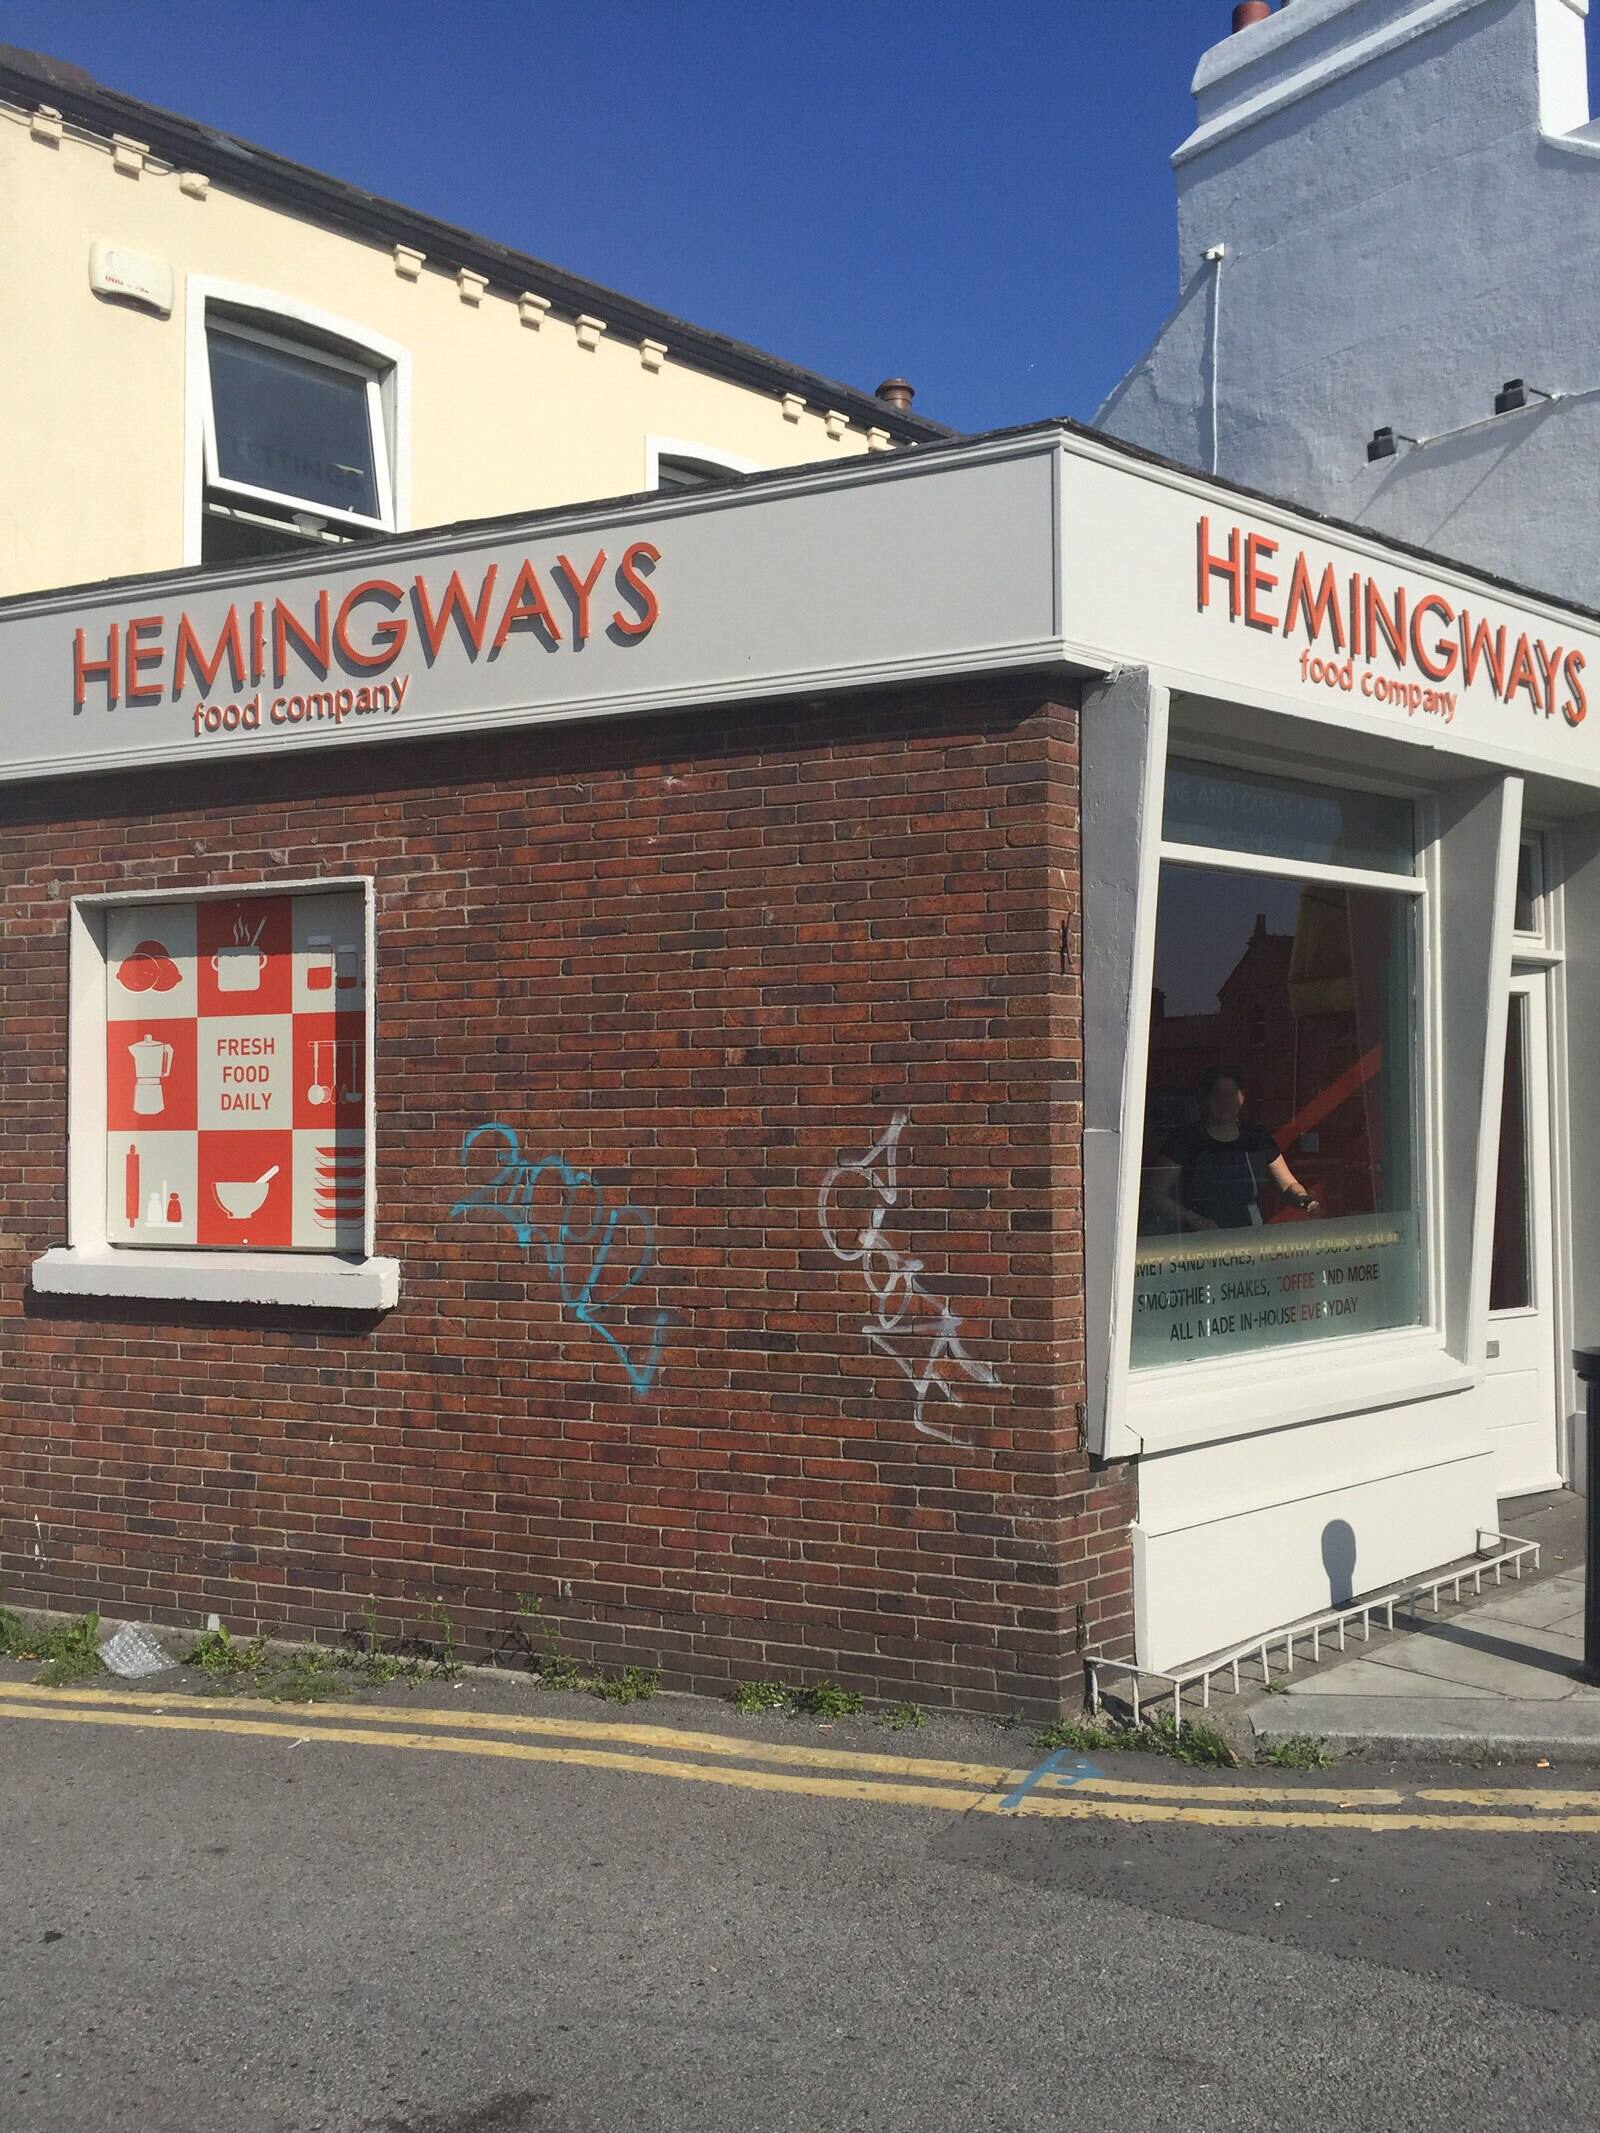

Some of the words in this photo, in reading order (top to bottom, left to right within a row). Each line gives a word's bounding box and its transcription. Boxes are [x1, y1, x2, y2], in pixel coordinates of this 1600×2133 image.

[74, 541, 662, 705] HEMINGWAYS
[1197, 514, 1589, 727] HEMINGWAYS
[1300, 648, 1354, 691] food
[1360, 670, 1457, 724] company
[194, 694, 262, 737] food
[270, 674, 411, 723] company
[216, 1037, 276, 1056] FRESH
[222, 1065, 270, 1083] FOOD
[220, 1093, 272, 1111] DAILY
[1220, 1278, 1271, 1301] SHAKES,
[1347, 1263, 1379, 1282] MORE
[1170, 1322, 1193, 1342] ALL
[1240, 1306, 1297, 1331] IN-HOUSE
